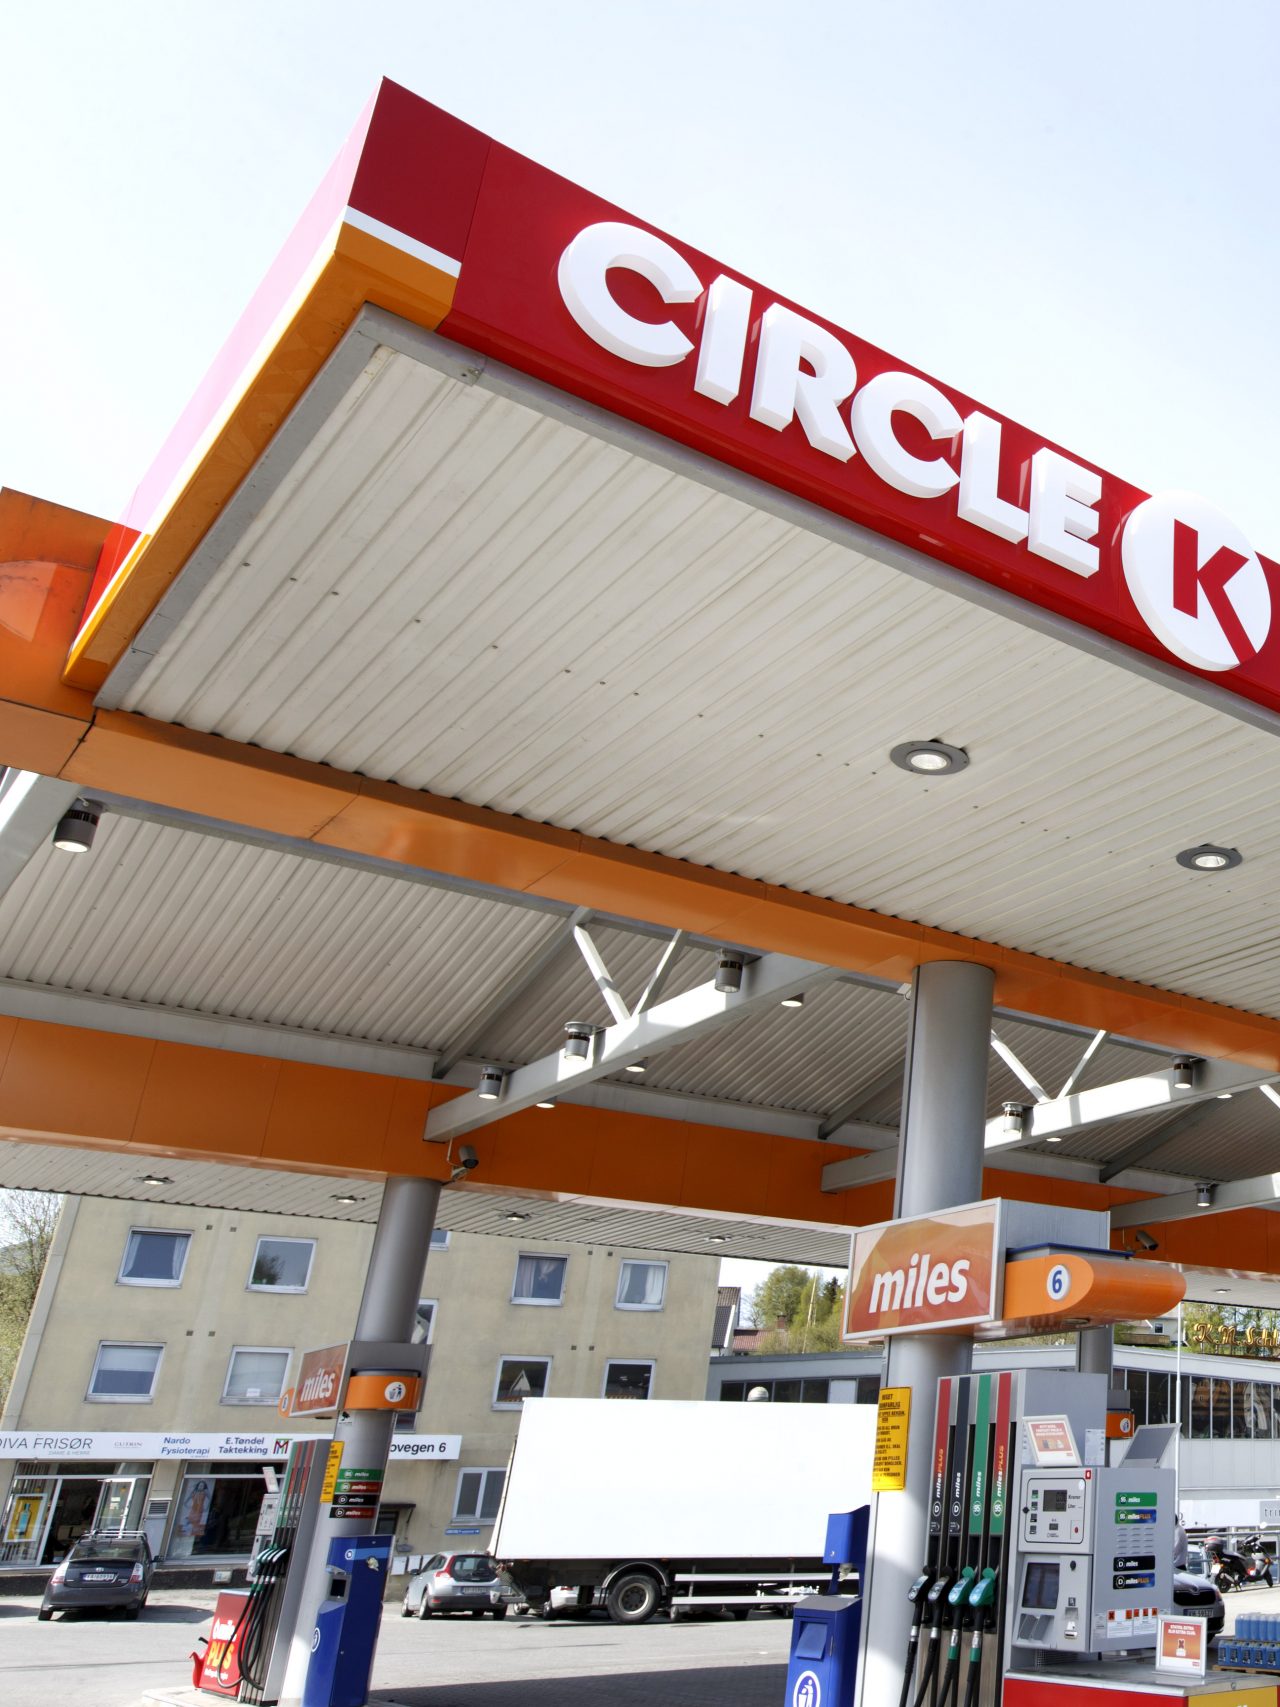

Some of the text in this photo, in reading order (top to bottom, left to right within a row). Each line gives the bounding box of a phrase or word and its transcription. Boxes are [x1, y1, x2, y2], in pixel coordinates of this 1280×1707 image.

[558, 221, 1257, 665] CIRCLE K
[868, 1252, 970, 1313] miles
[1052, 1270, 1062, 1293] 6
[300, 1367, 336, 1402] miles
[33, 1437, 93, 1449] FRISØR
[163, 1437, 191, 1445] Nardo
[161, 1446, 210, 1455] Fysioterapi
[219, 1446, 268, 1455] Taktekking
[439, 1442, 446, 1453] 6
